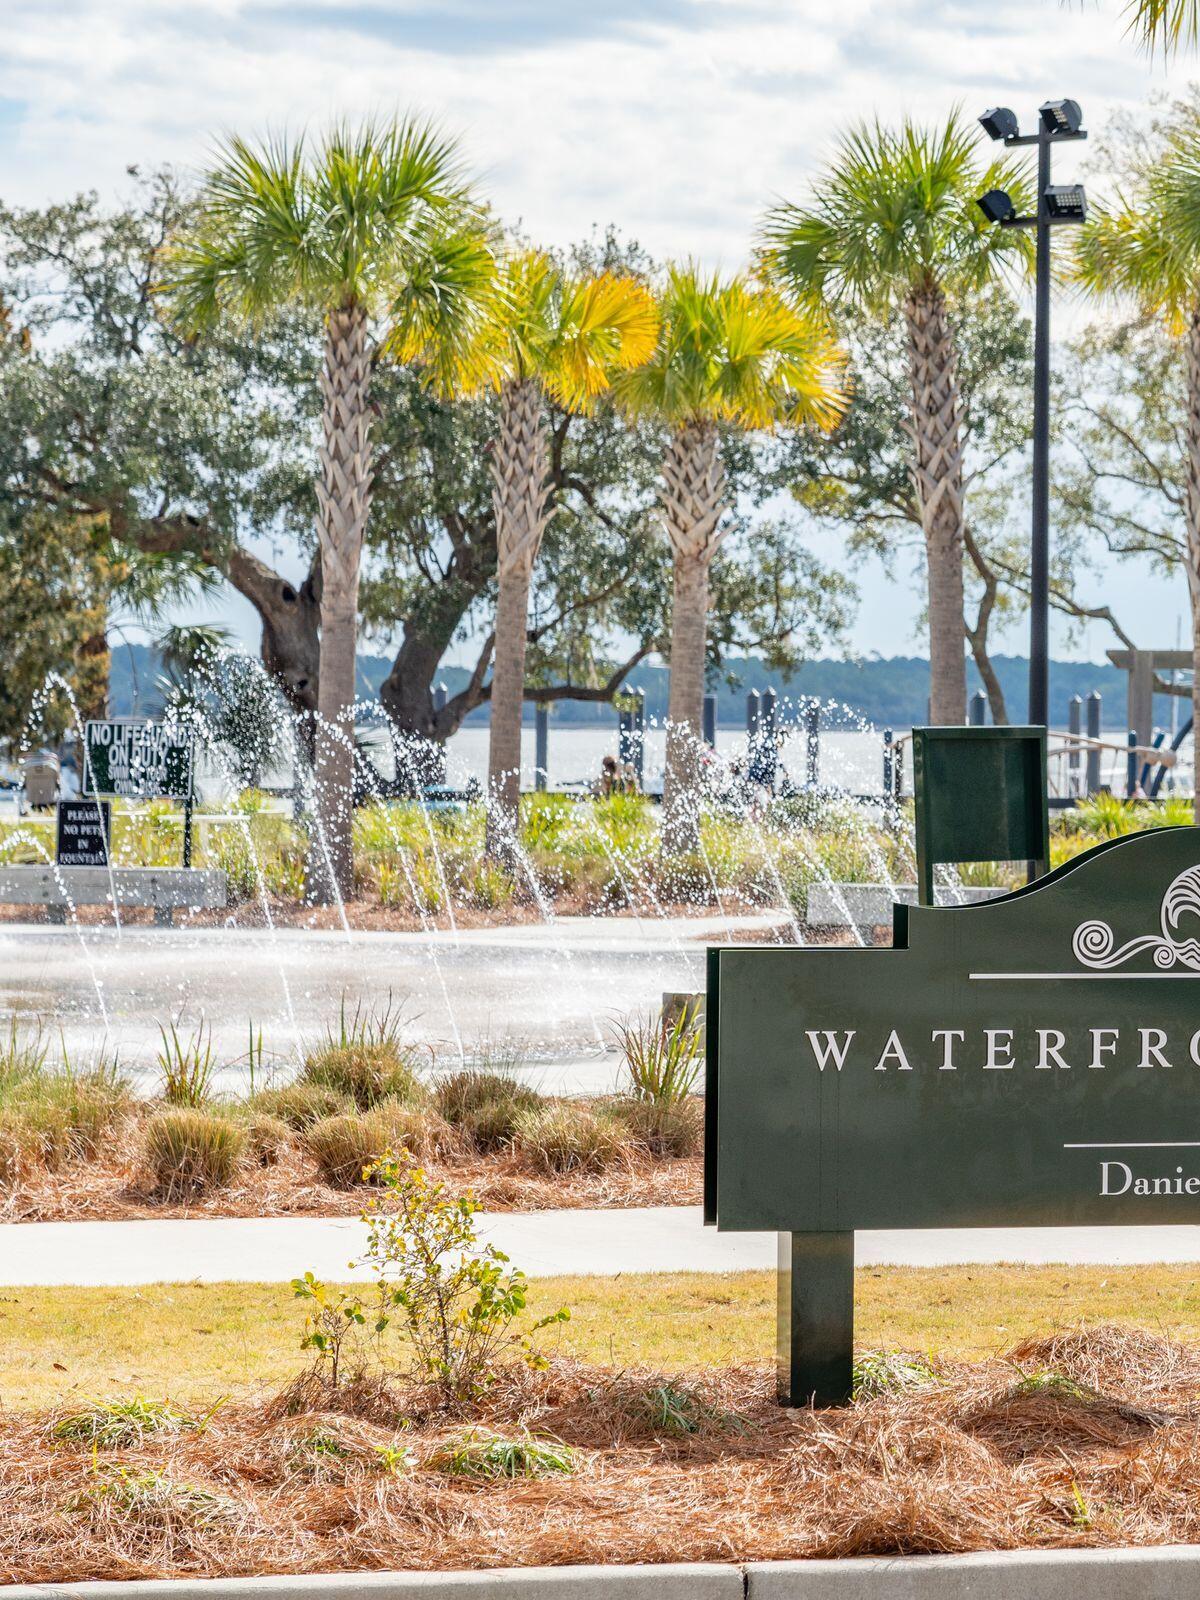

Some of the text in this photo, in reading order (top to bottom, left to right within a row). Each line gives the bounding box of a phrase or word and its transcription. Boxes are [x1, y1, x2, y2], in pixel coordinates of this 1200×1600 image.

[91, 724, 187, 748] NO LIFEGUARD
[108, 744, 169, 768] ON DUTY
[108, 765, 130, 781] SWIM
[67, 810, 102, 821] PLEASE
[63, 824, 79, 835] NO
[77, 838, 89, 850] IN
